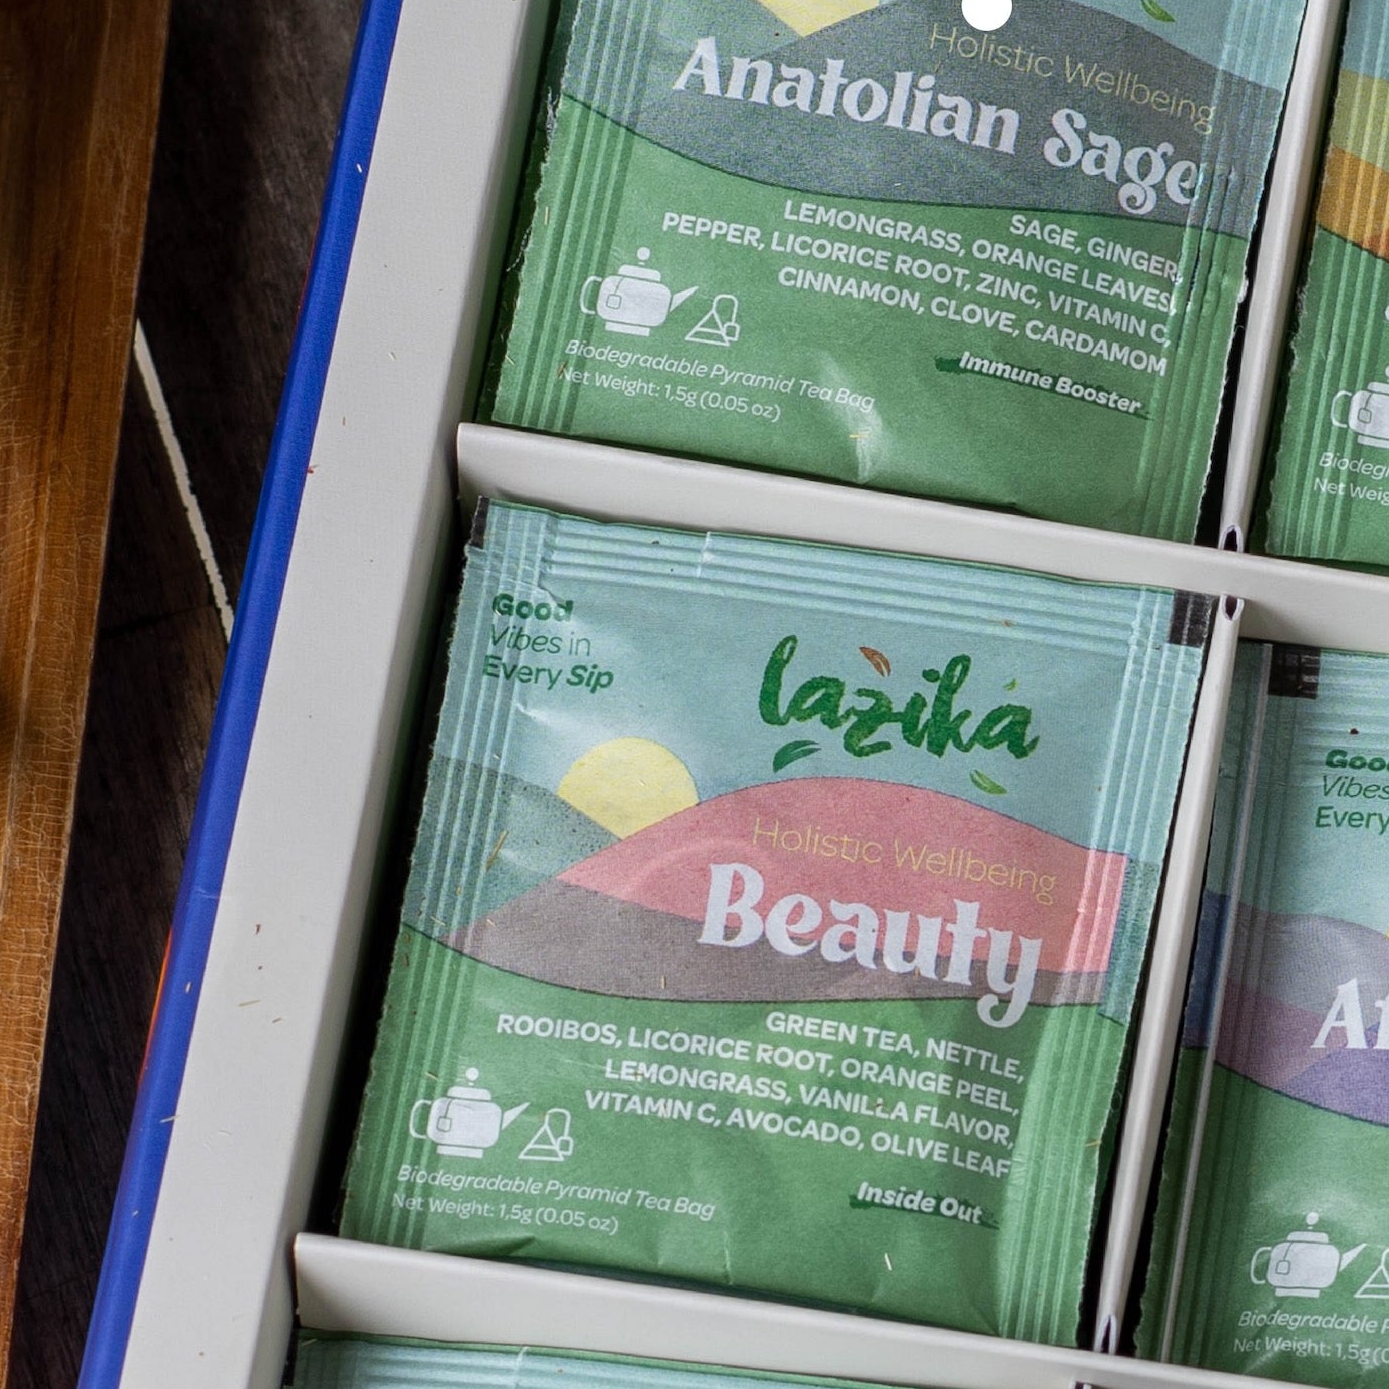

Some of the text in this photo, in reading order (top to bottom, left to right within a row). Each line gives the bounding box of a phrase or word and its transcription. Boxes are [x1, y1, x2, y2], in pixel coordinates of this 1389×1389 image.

[929, 24, 1216, 135] Holistic Wellbeing
[672, 37, 1200, 214] Anatolian Sage
[960, 351, 1141, 413] Immune Booster
[1313, 477, 1347, 496] Net
[697, 863, 1042, 1027] Beauty
[858, 1182, 982, 1224] Inside Out
